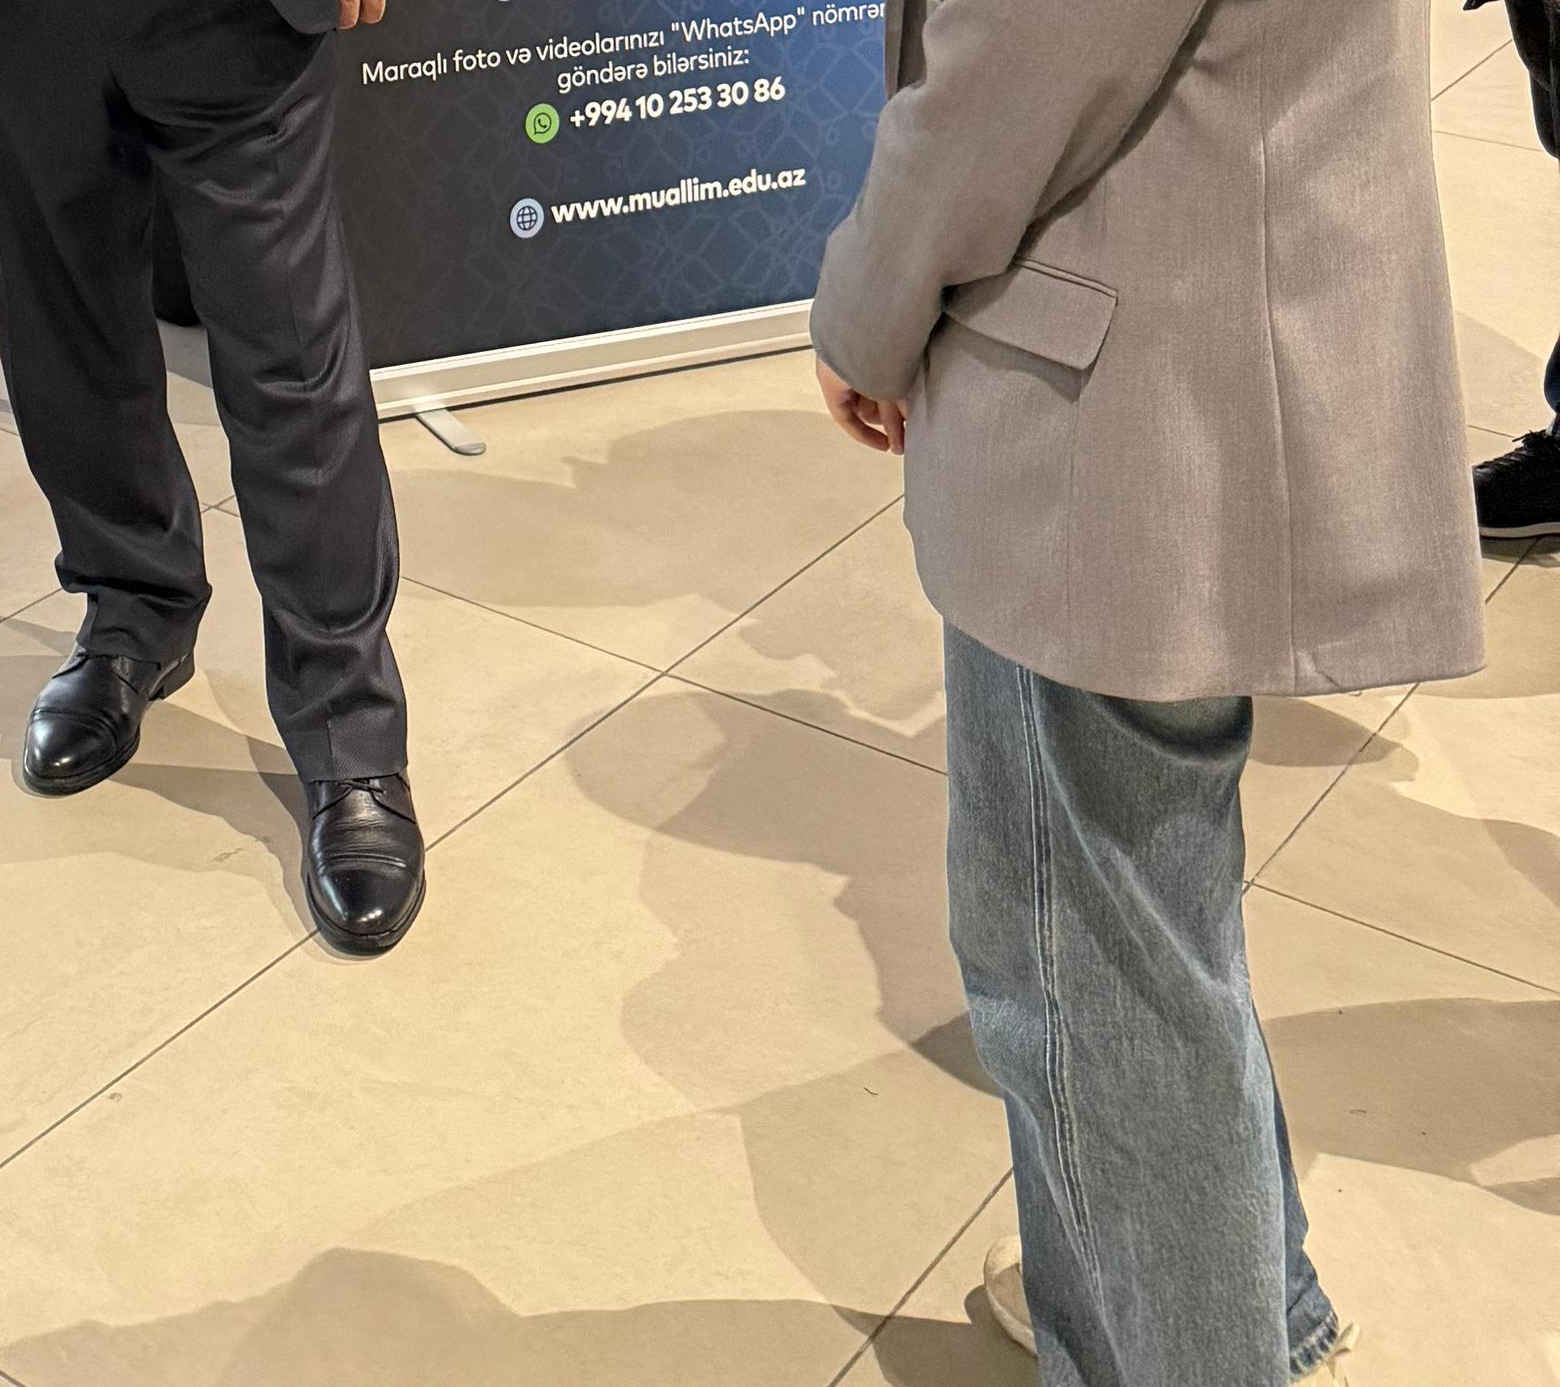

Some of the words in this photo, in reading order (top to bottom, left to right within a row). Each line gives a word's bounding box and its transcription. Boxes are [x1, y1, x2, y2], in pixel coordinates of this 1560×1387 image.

[362, 52, 448, 85] Maraqlı
[452, 49, 501, 72] foto
[506, 47, 532, 65] və
[536, 30, 665, 61] videolarınızı
[671, 7, 806, 42] "WhatsApp"
[557, 60, 648, 94] göndərə
[653, 46, 750, 77] bilərsiniz:
[570, 97, 632, 128] +994
[636, 93, 664, 120] 10
[668, 86, 712, 115] 253
[716, 80, 749, 108] 30
[754, 76, 786, 102] 86
[551, 168, 806, 224] www.muallim.edu.az
